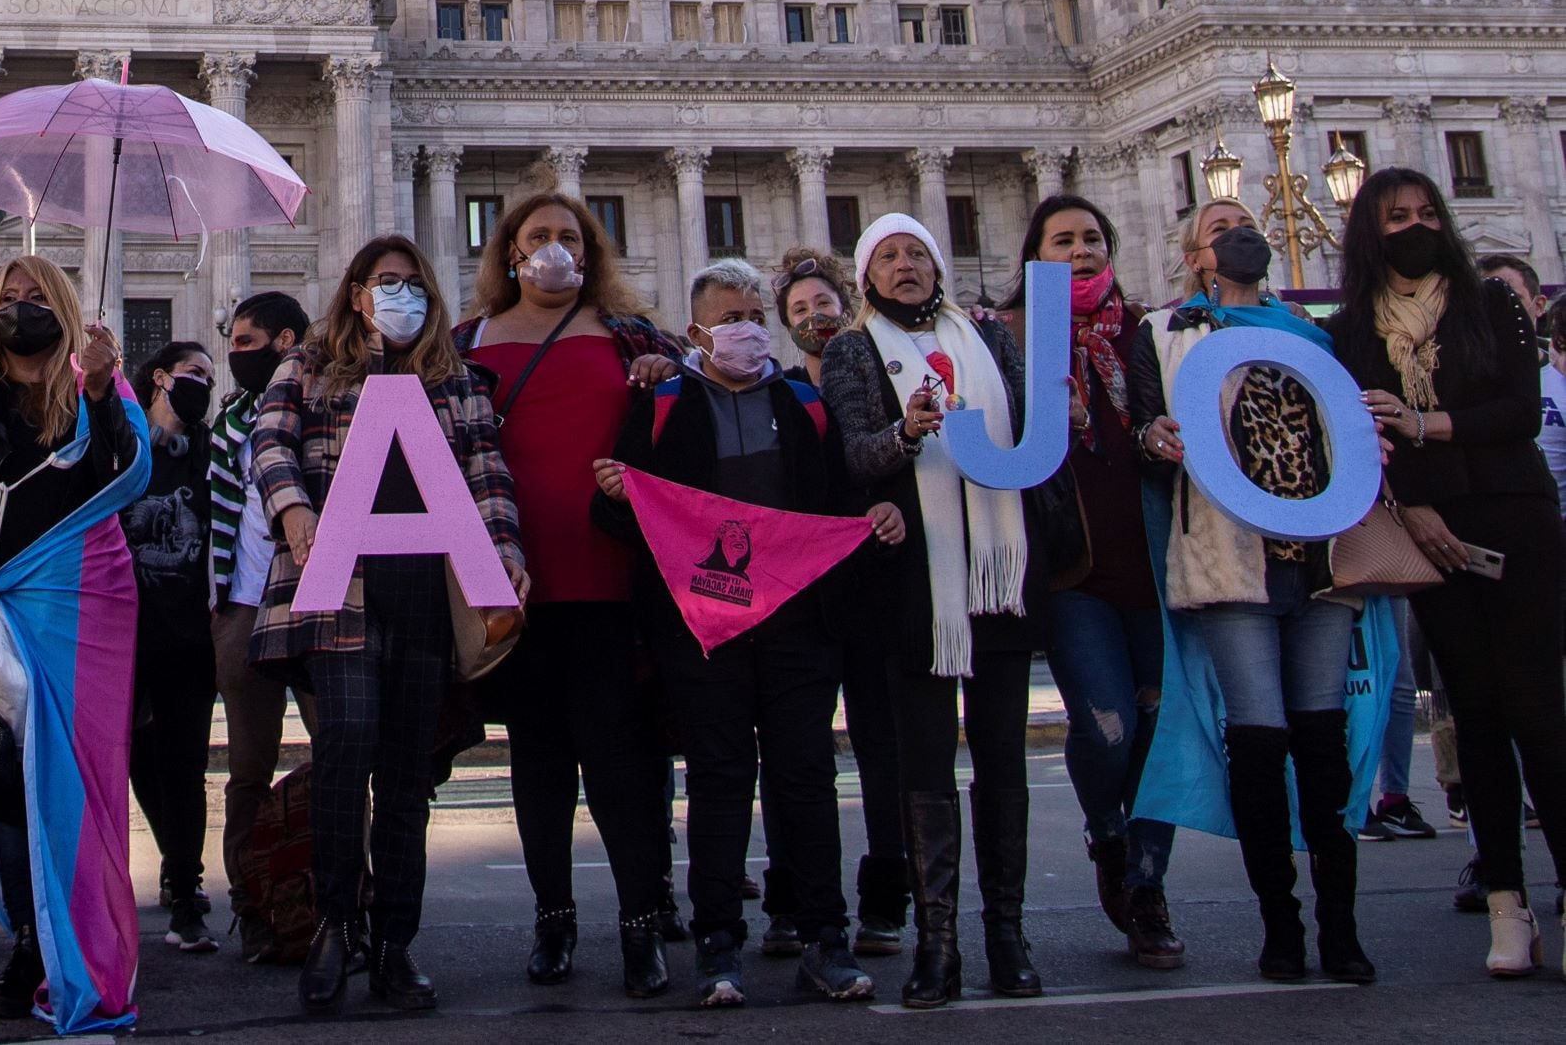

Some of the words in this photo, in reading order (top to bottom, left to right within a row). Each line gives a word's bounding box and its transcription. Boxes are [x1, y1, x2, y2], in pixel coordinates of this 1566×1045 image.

[290, 374, 521, 612] A
[945, 261, 1071, 490] J
[1172, 326, 1382, 541] O
